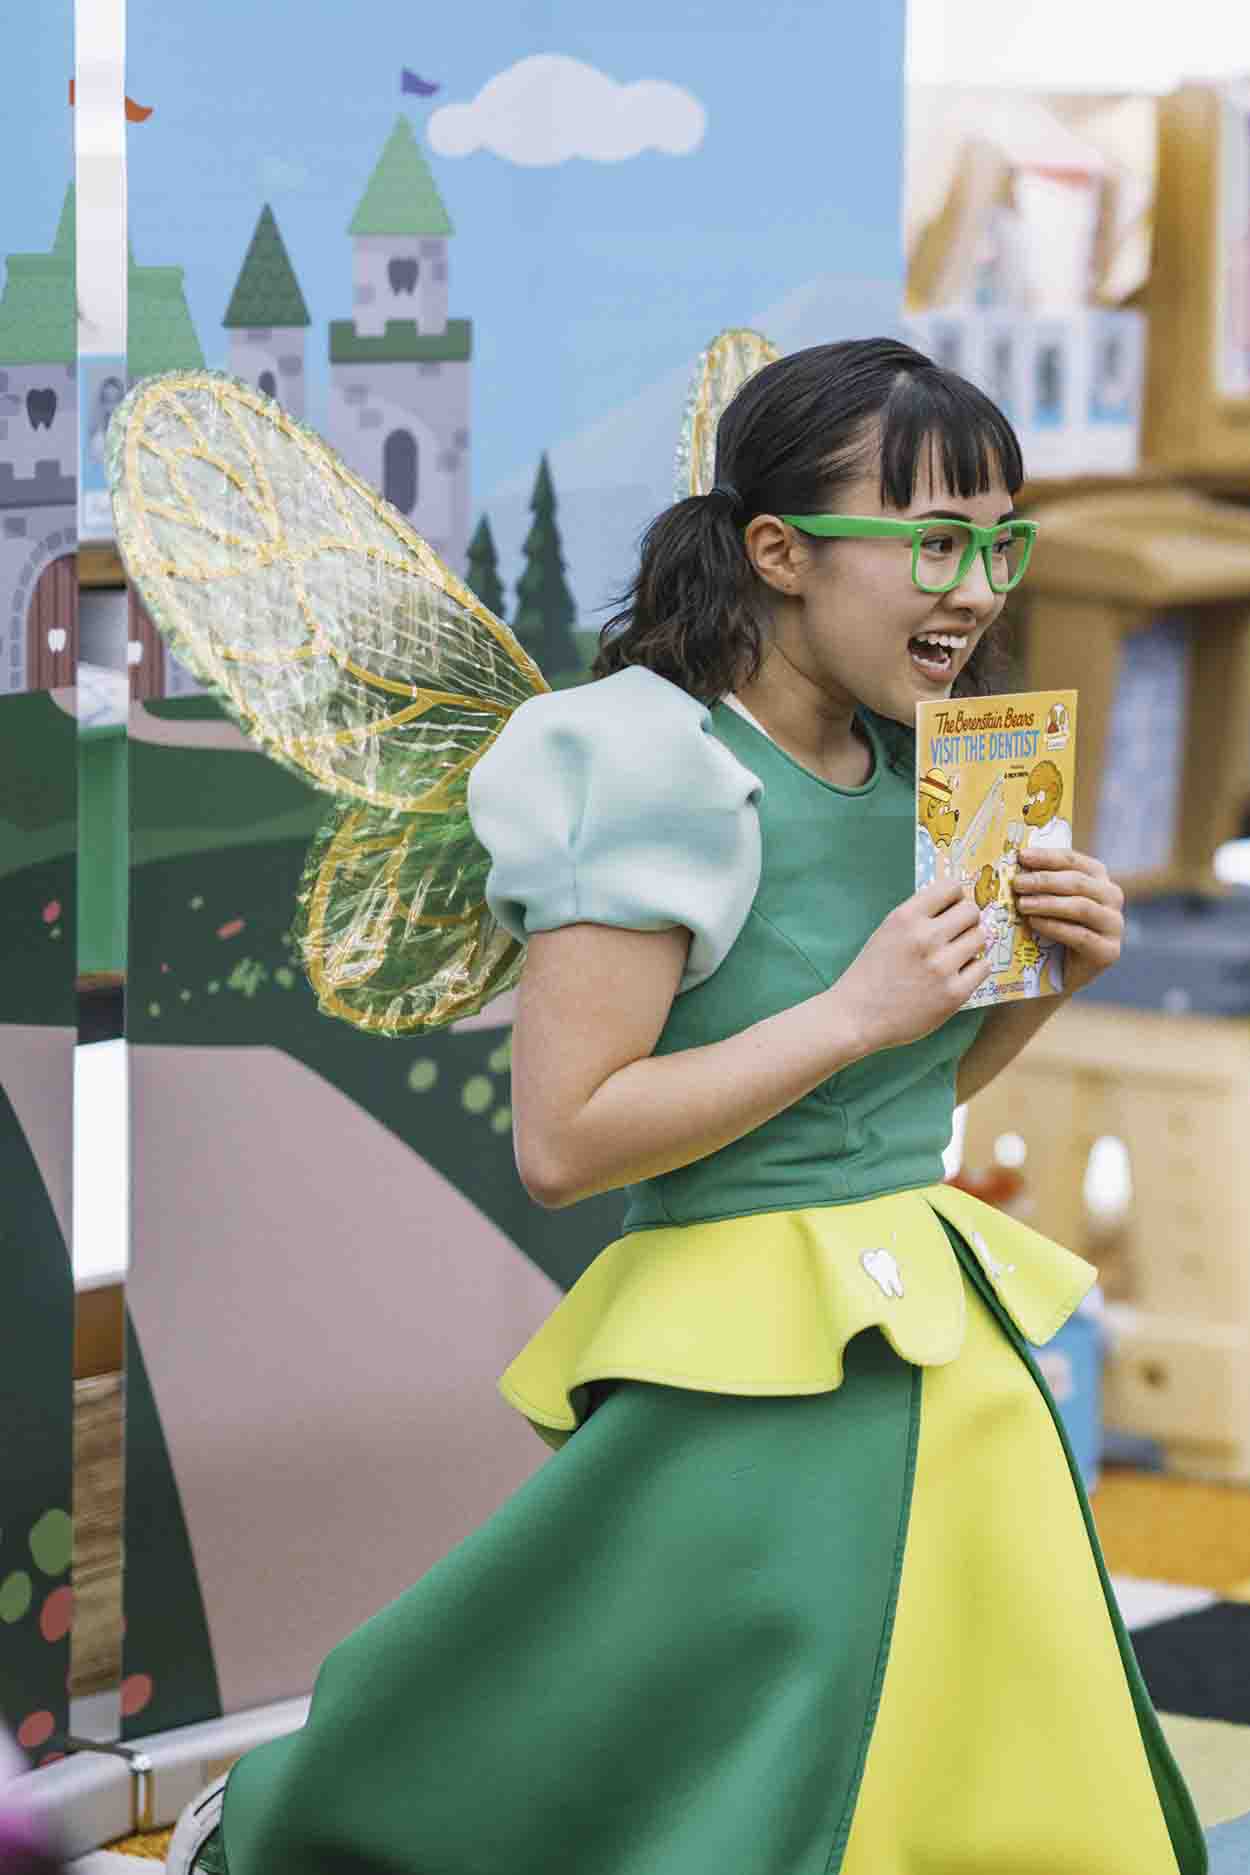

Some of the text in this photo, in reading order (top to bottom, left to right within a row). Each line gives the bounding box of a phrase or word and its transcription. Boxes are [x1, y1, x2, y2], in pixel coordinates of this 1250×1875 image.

[936, 707, 1035, 735] The Berenstain Bears
[930, 735, 961, 766] VISIT
[963, 734, 985, 762] THE
[989, 729, 1040, 761] DENTIST
